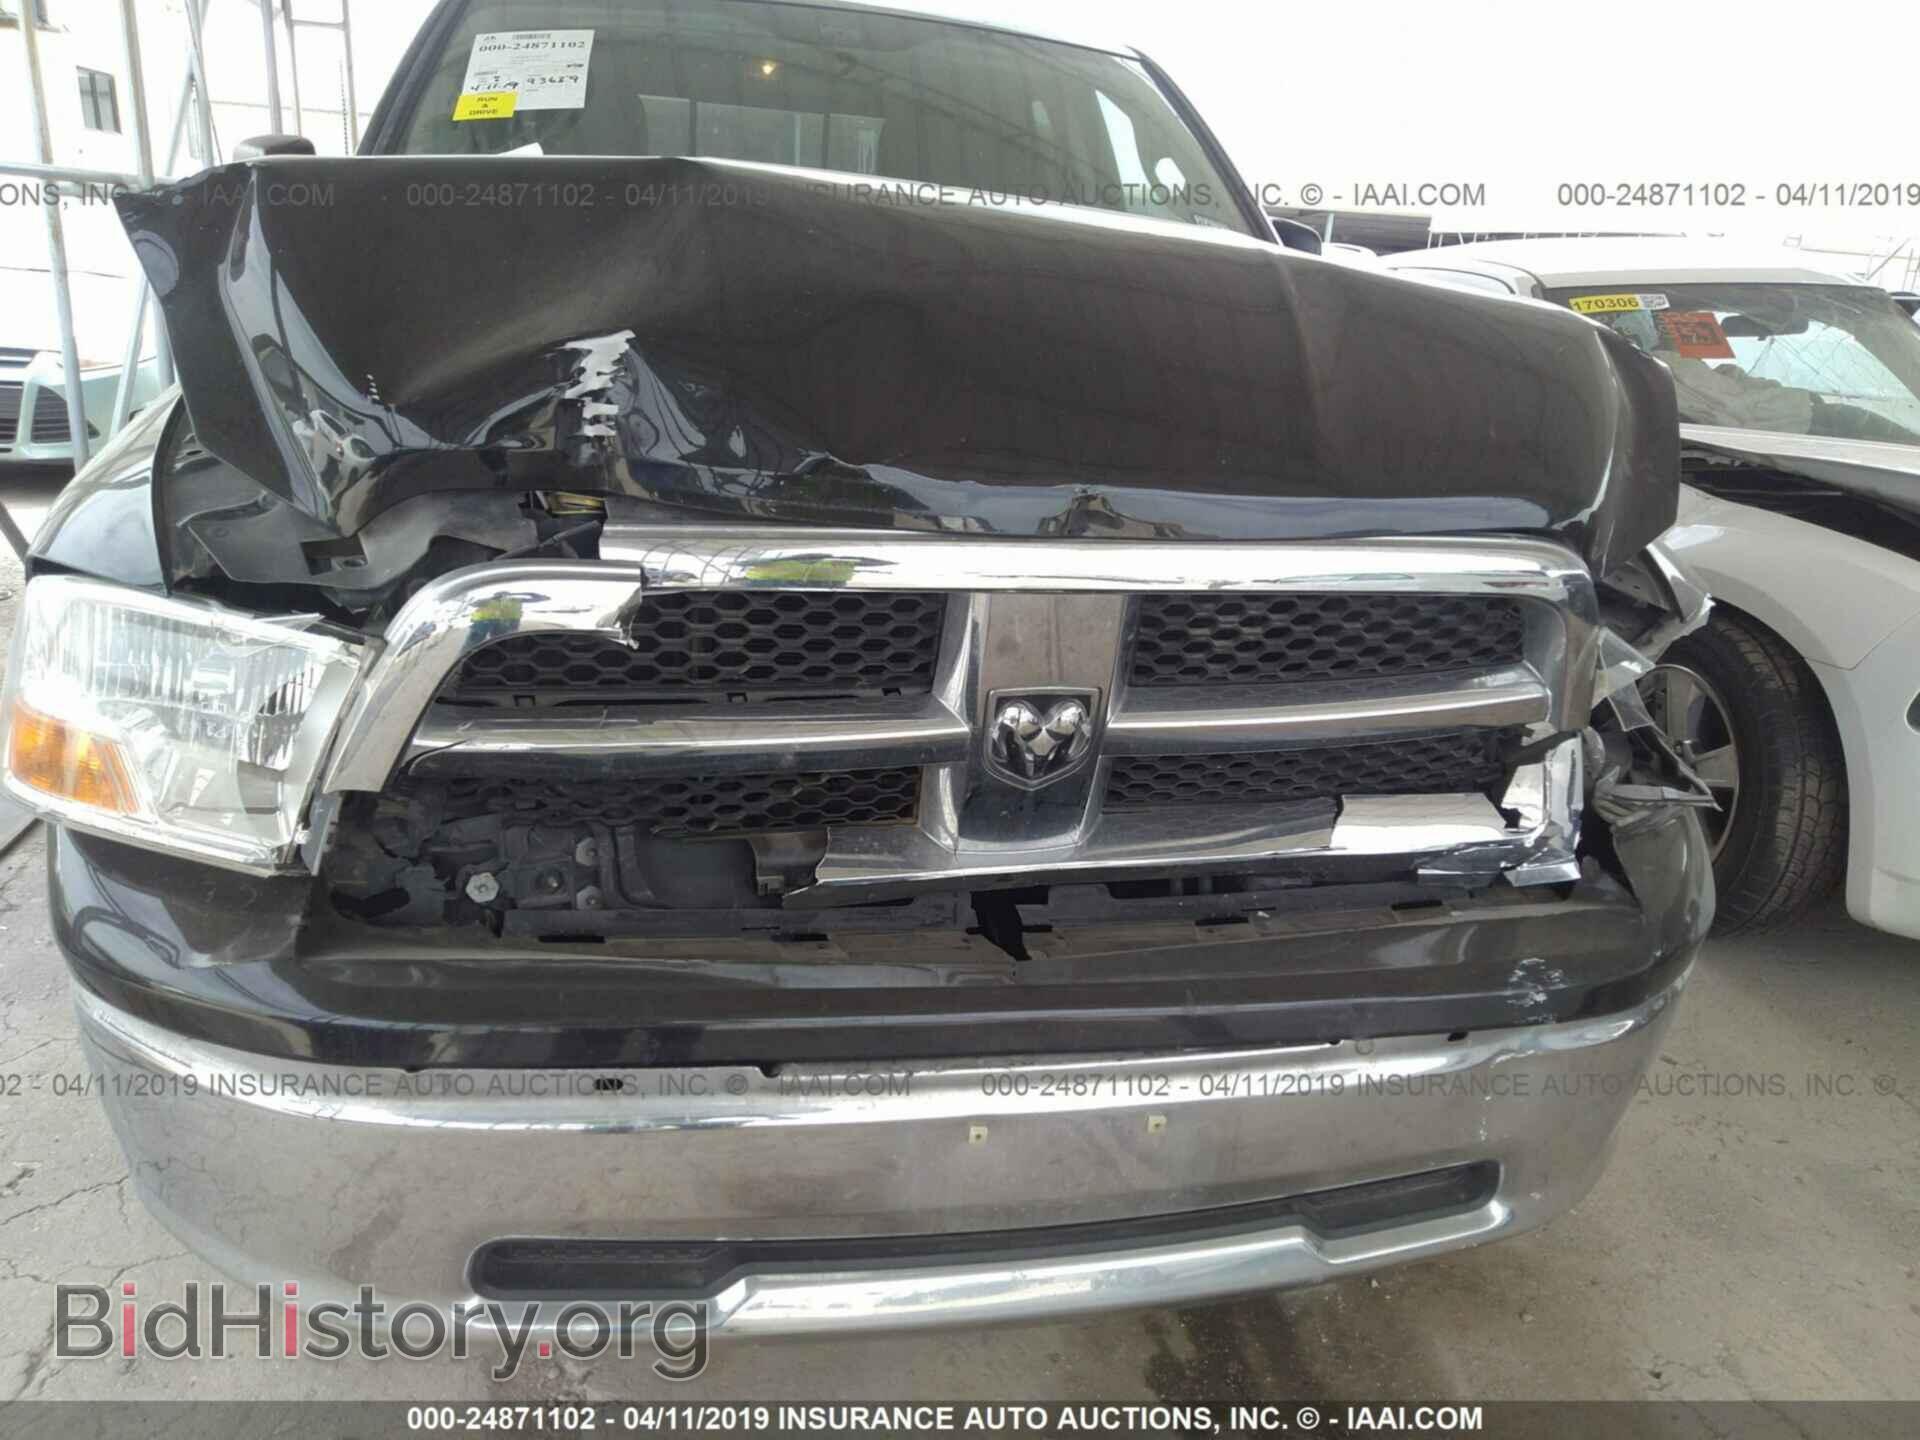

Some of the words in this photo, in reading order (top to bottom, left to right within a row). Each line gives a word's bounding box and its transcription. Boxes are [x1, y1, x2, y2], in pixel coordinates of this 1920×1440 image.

[478, 40, 586, 53] 000-24871102
[469, 108, 499, 116] DRIVE
[1573, 297, 1640, 312] 170306
